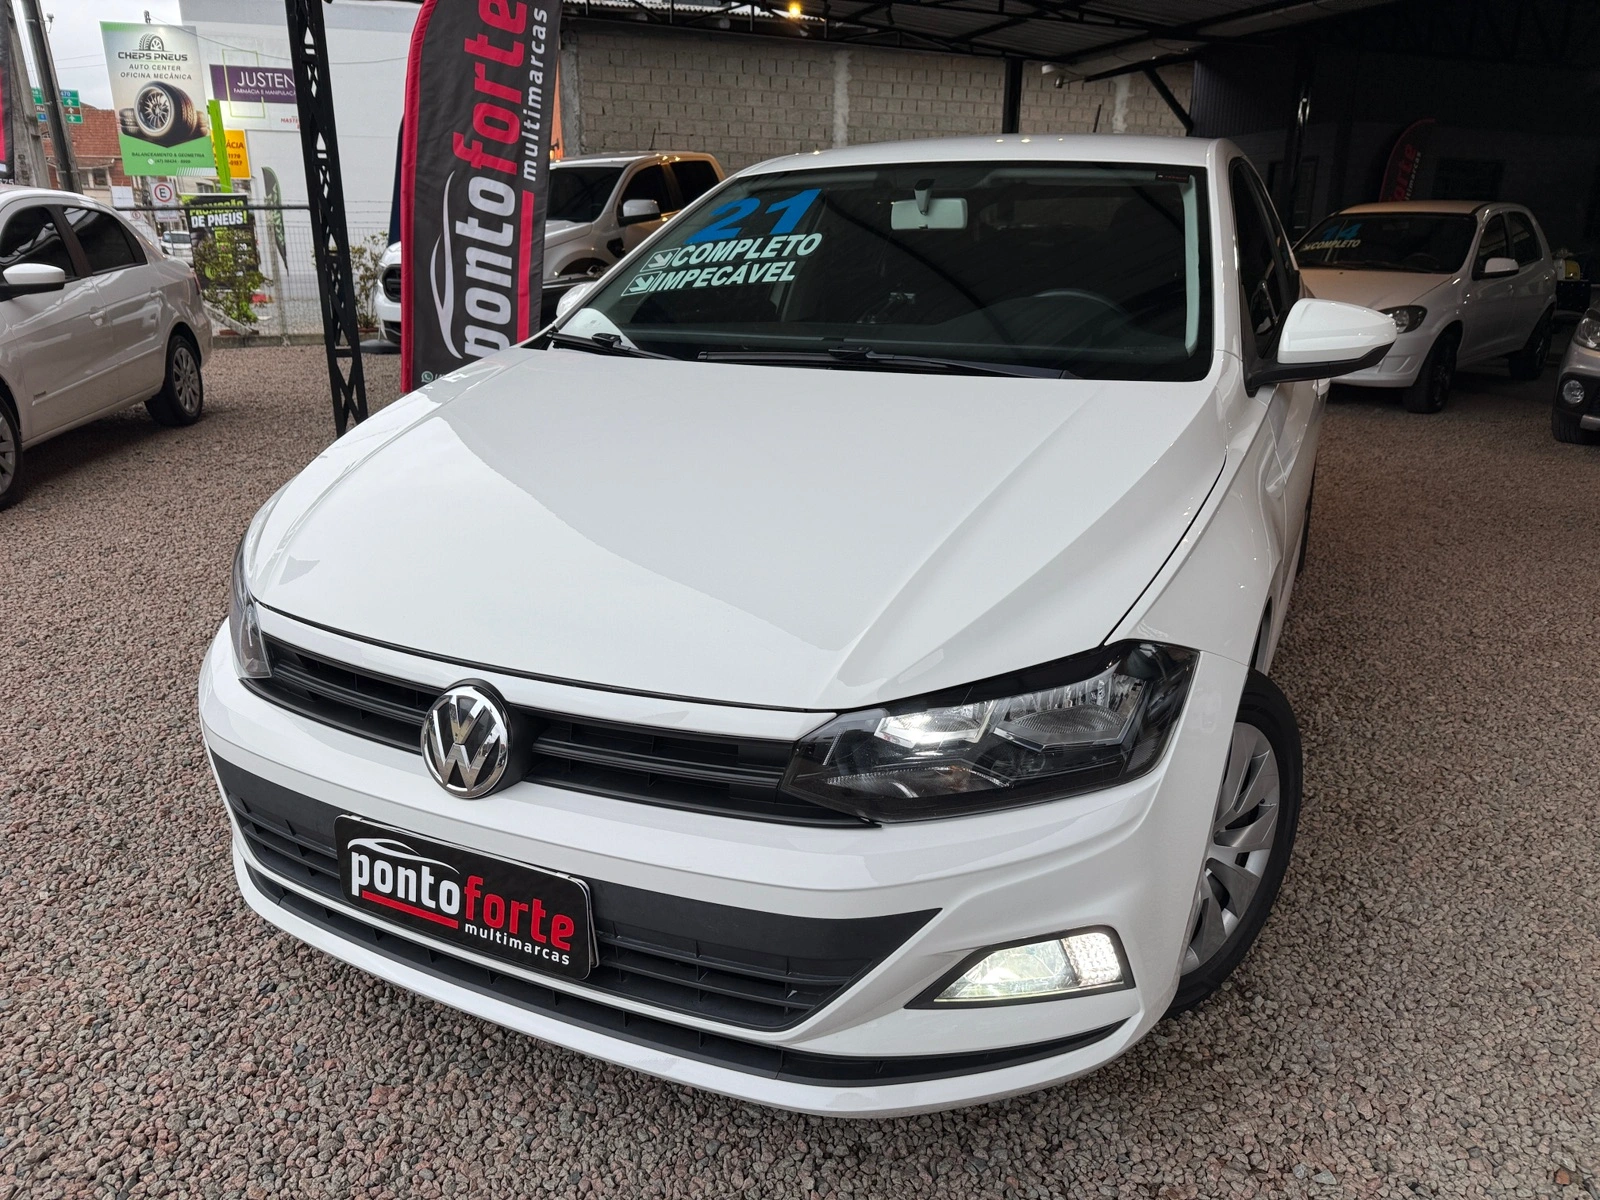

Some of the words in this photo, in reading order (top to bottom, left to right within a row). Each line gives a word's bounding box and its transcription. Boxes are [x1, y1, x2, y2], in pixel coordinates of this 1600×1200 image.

[118, 51, 152, 60] CHEPS
[153, 53, 188, 61] PNEUS
[120, 71, 151, 79] OFICINA
[237, 71, 296, 88] JUSTEN
[521, 7, 548, 182] multimarcas
[159, 187, 167, 198] E
[191, 215, 206, 229] DE
[684, 188, 822, 245] 21
[670, 232, 823, 268] COMPLETO
[1311, 239, 1362, 250] COMPLETO
[649, 261, 797, 293] IMPECÁVEL
[464, 922, 571, 966] multimarcas
